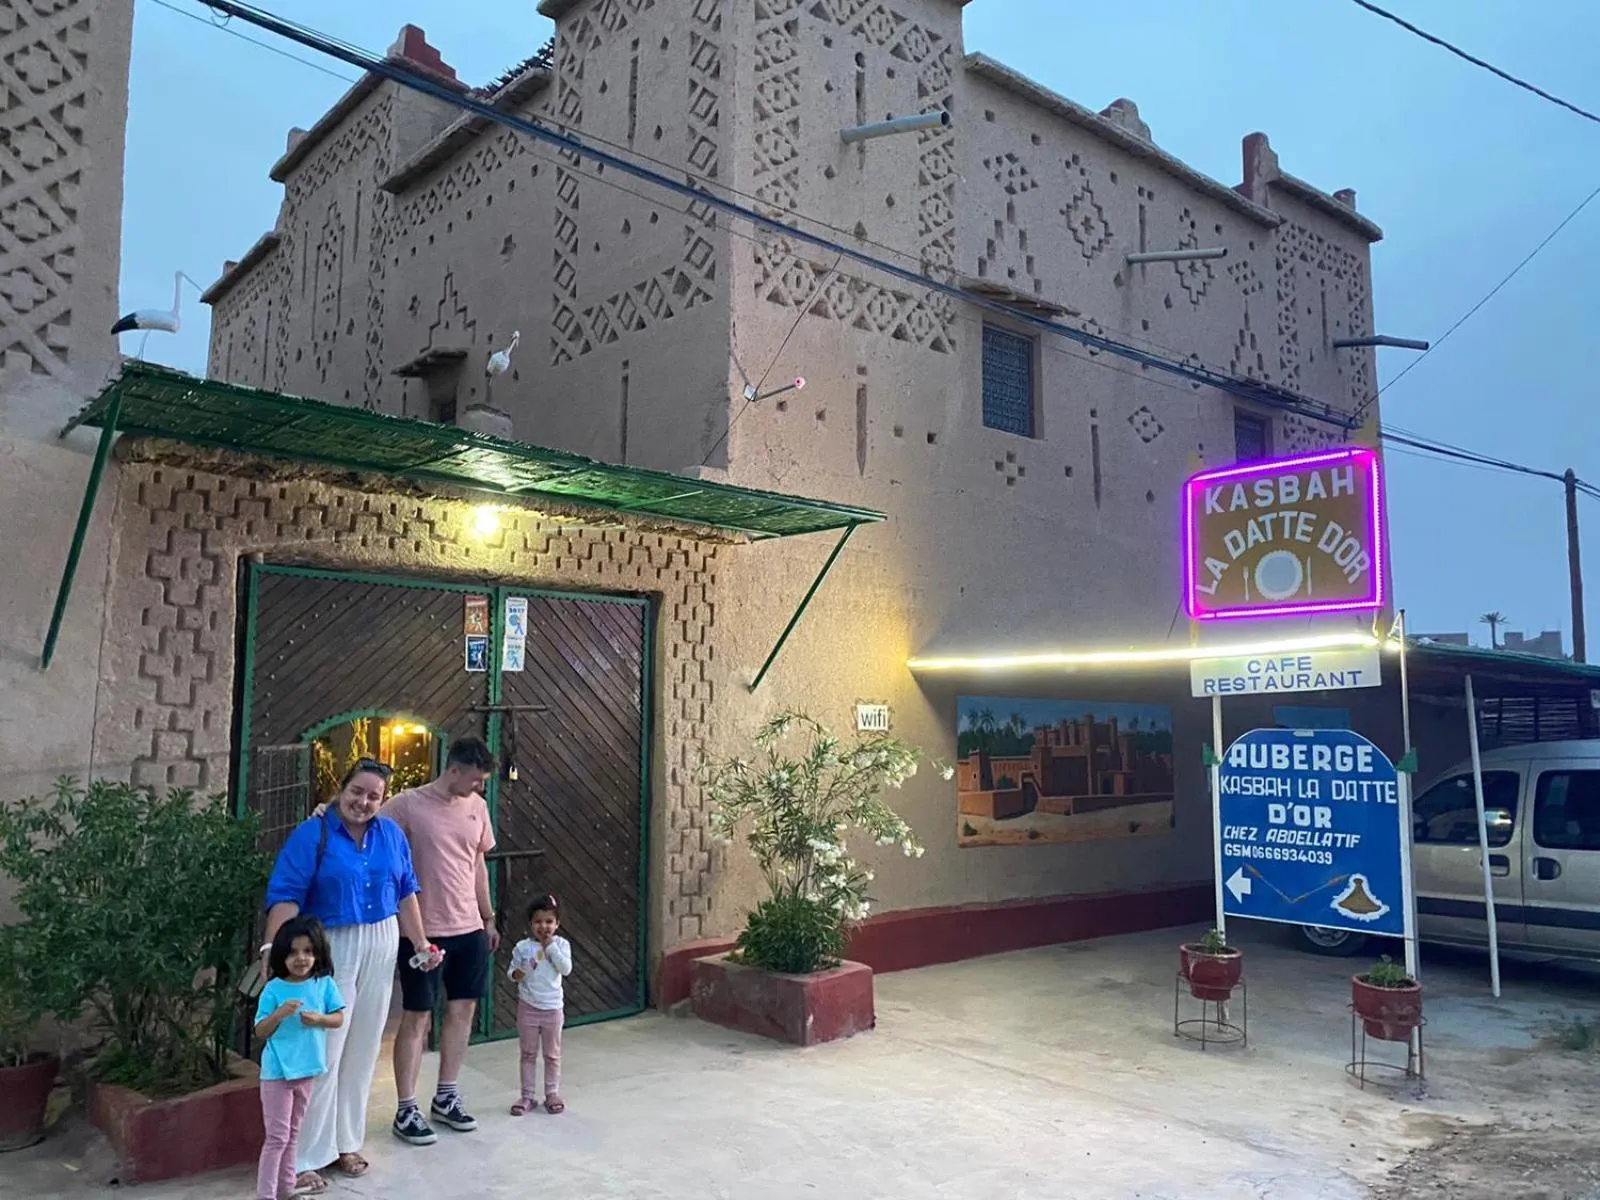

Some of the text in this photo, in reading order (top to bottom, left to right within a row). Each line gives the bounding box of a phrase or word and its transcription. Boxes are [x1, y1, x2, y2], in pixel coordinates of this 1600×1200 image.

[1205, 465, 1355, 514] KASBAH
[1196, 557, 1230, 596] LA
[1224, 511, 1317, 560] DATTE
[1247, 656, 1313, 674] CAFE
[1204, 671, 1363, 693] RESTAURANT
[861, 708, 886, 727] wifi
[1229, 743, 1374, 773] AUBERGE
[1220, 776, 1397, 804] KASBAH LA DATTE
[1268, 803, 1332, 828] D'OR
[1224, 826, 1361, 848] CHEZ ABDELLATIF
